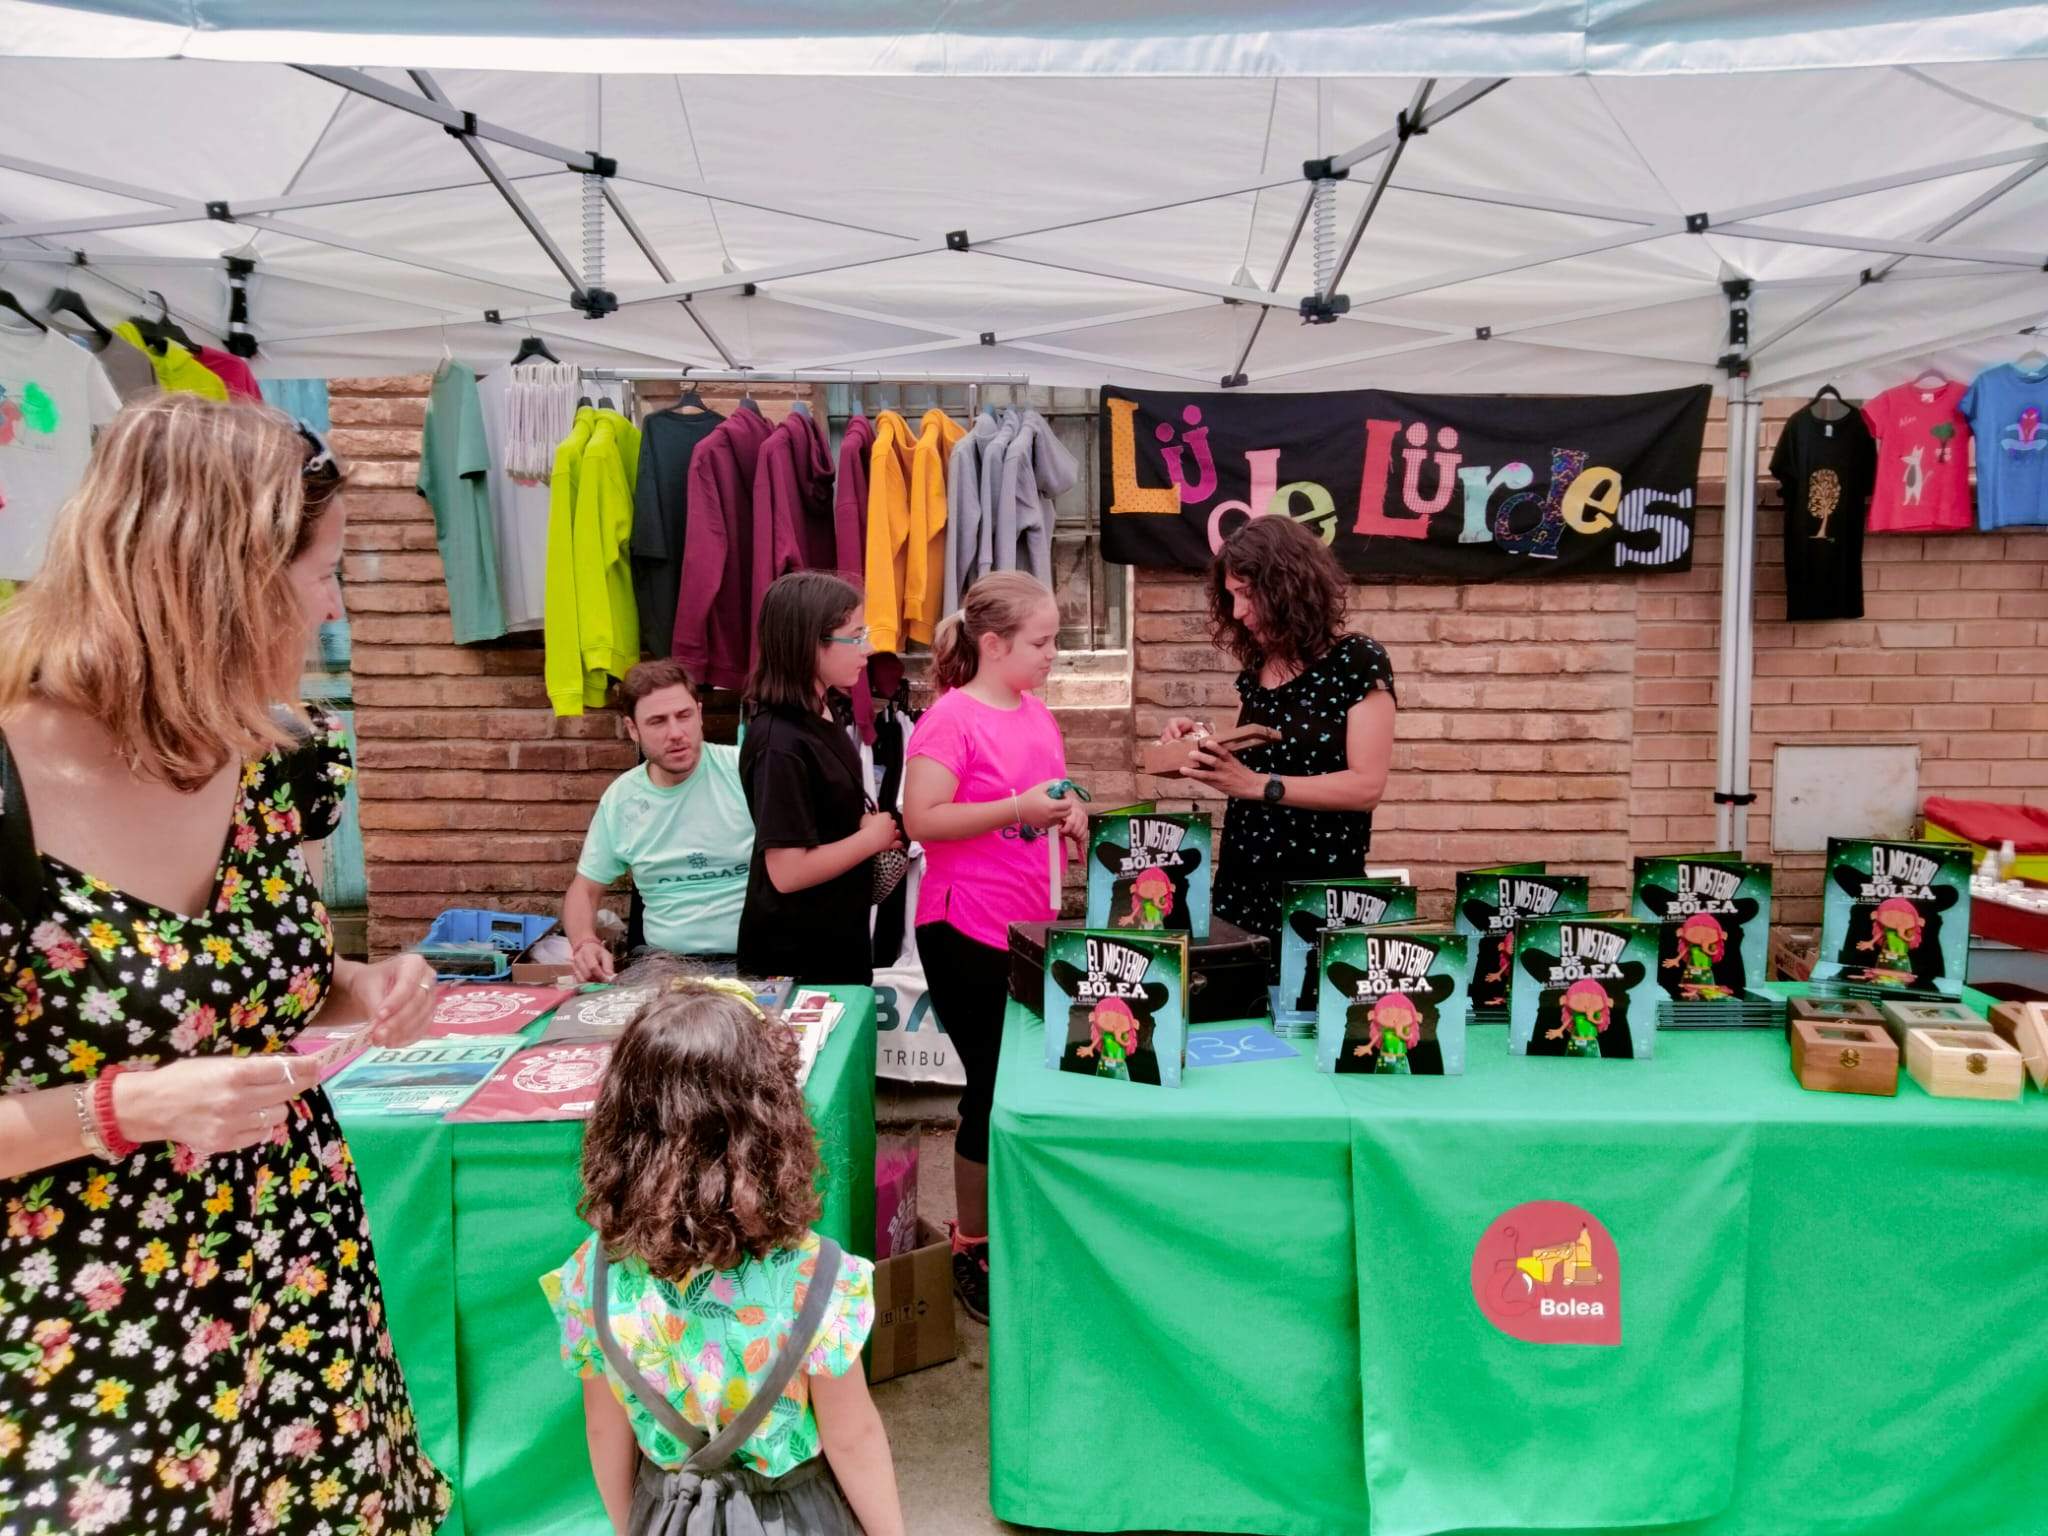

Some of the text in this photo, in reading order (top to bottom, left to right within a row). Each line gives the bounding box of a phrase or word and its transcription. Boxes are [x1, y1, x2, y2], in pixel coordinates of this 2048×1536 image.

[1107, 397, 1693, 568] Lü de Lürdes
[1129, 818, 1185, 852] EL MISTERIO
[1120, 851, 1184, 871] BOLEA
[1130, 847, 1148, 857] DE
[1872, 846, 1939, 886] EL MISTERIO
[1678, 863, 1741, 899] EL MISTERIO
[1872, 875, 1892, 885] DE
[1499, 878, 1559, 914] EL MISTERIO
[1677, 892, 1698, 902] DE
[1860, 883, 1936, 900] BOLEA
[1326, 888, 1387, 924] EL MISTERIO
[1499, 907, 1518, 916] DE
[1667, 901, 1739, 914] BOLEA
[1326, 918, 1345, 928] DE
[1560, 925, 1627, 964] EL MISTERIO
[1086, 938, 1149, 983] EL MISTERIO
[1367, 937, 1434, 977] EL MISTERIO
[1560, 956, 1581, 967] DE
[1088, 971, 1106, 982] DE
[1368, 969, 1388, 980] DE
[1549, 964, 1624, 981] BOLEA
[1077, 981, 1149, 1000] BOLEA
[1356, 977, 1433, 995] BOLEA
[369, 1046, 506, 1064] BOLEA
[883, 1049, 946, 1067] TRIBU
[1539, 1298, 1604, 1317] Bolea
